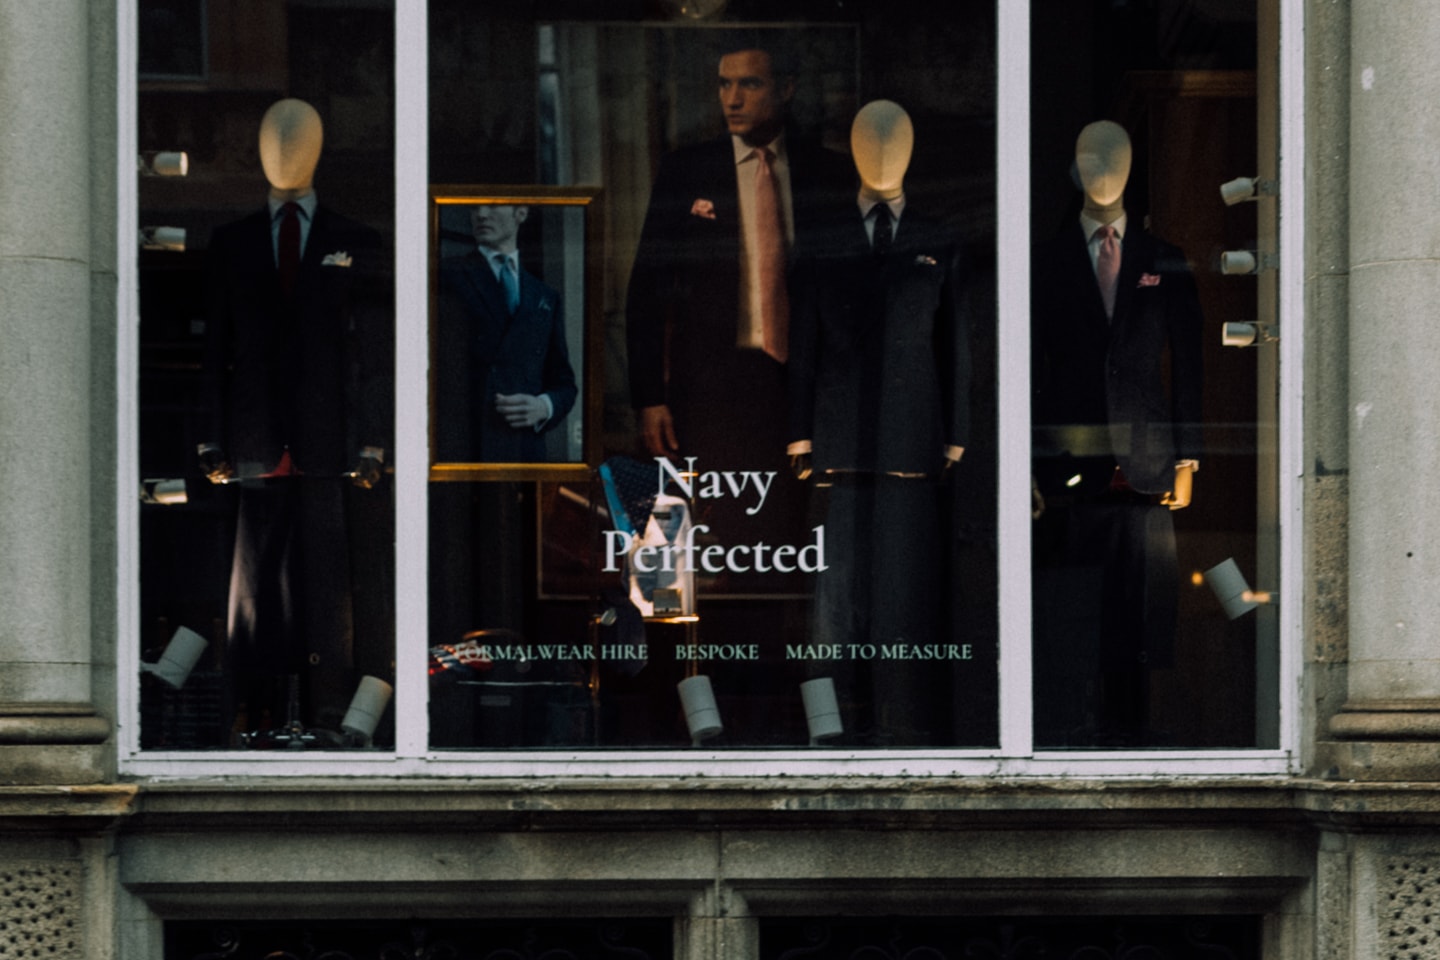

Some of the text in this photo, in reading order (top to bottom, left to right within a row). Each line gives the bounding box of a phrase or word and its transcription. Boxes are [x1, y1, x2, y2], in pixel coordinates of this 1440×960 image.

[654, 456, 777, 516] Navy
[602, 525, 829, 573] Perfected
[455, 643, 649, 661] FORMALWEAR HIRE
[675, 643, 760, 661] BESPOKE
[785, 643, 972, 660] MADE TO MEASURE
